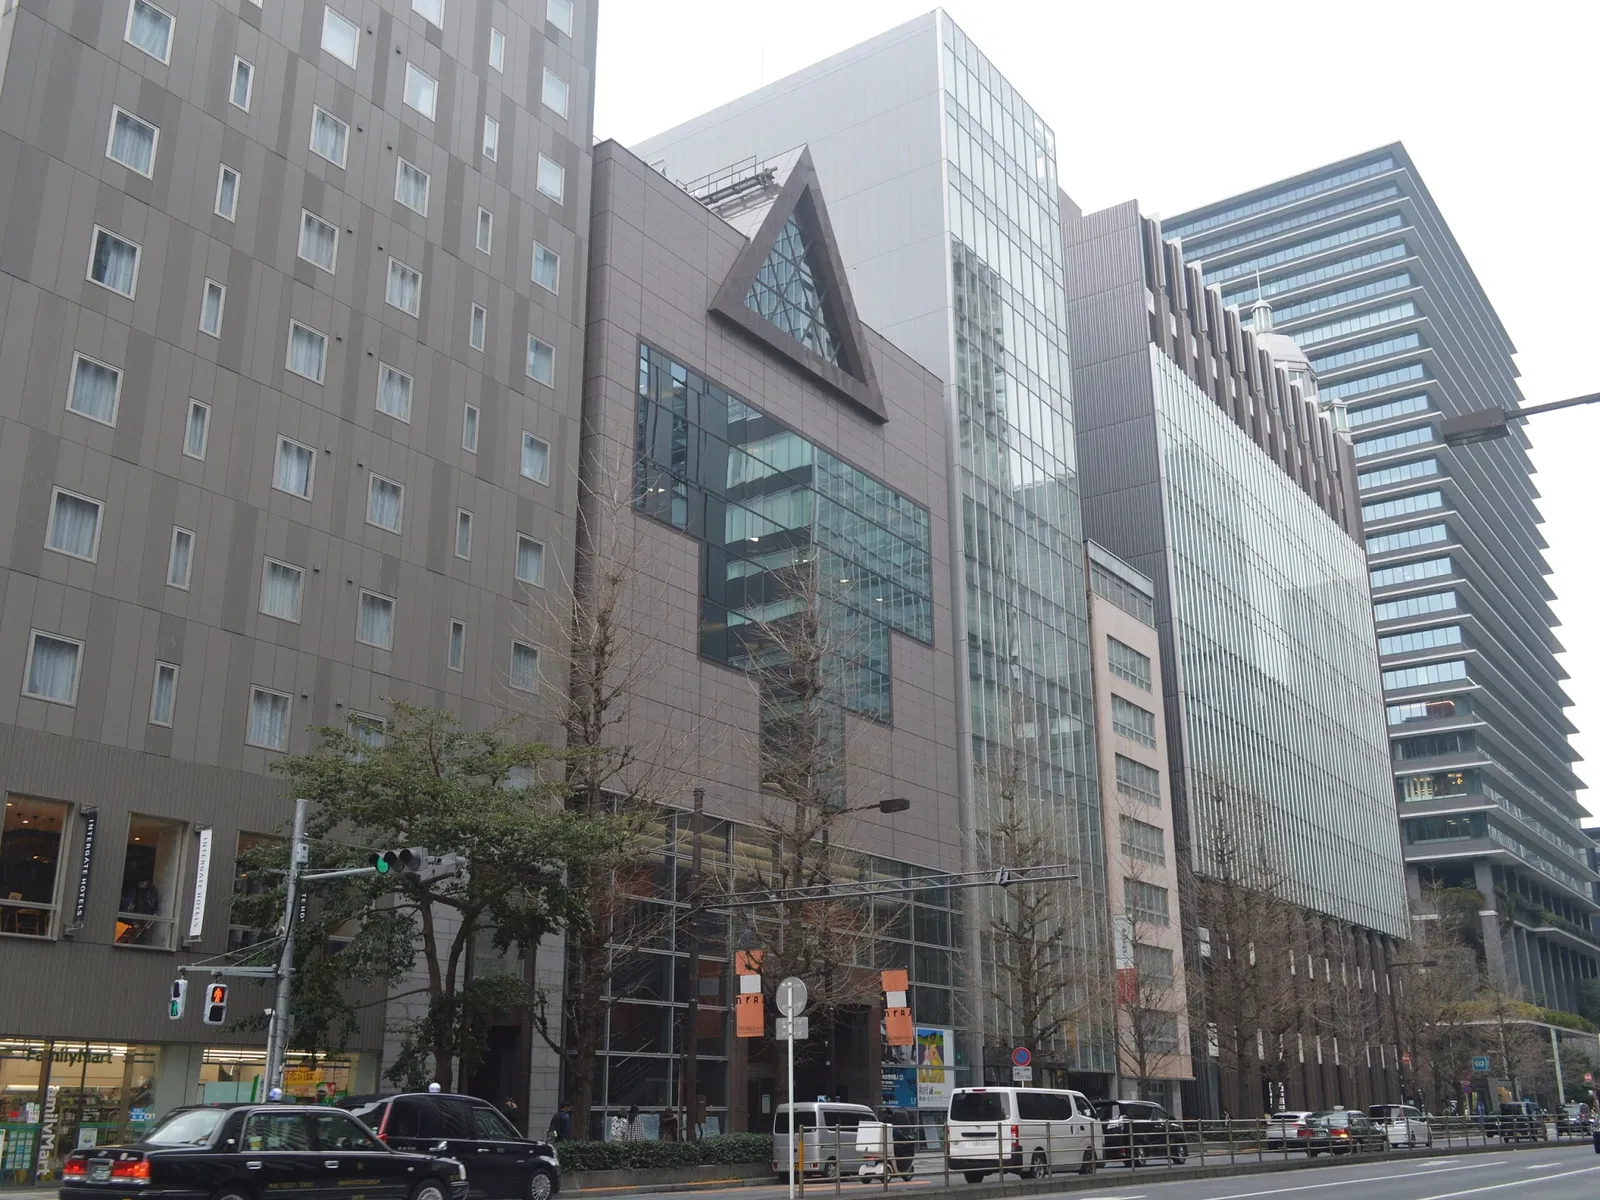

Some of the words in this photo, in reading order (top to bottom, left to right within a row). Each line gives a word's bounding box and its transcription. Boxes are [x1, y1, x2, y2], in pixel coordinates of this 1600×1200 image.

[82, 819, 95, 875] INTERGATE
[197, 837, 208, 888] INTERGATE
[76, 878, 87, 916] HOTELS
[193, 892, 202, 928] HOTELS
